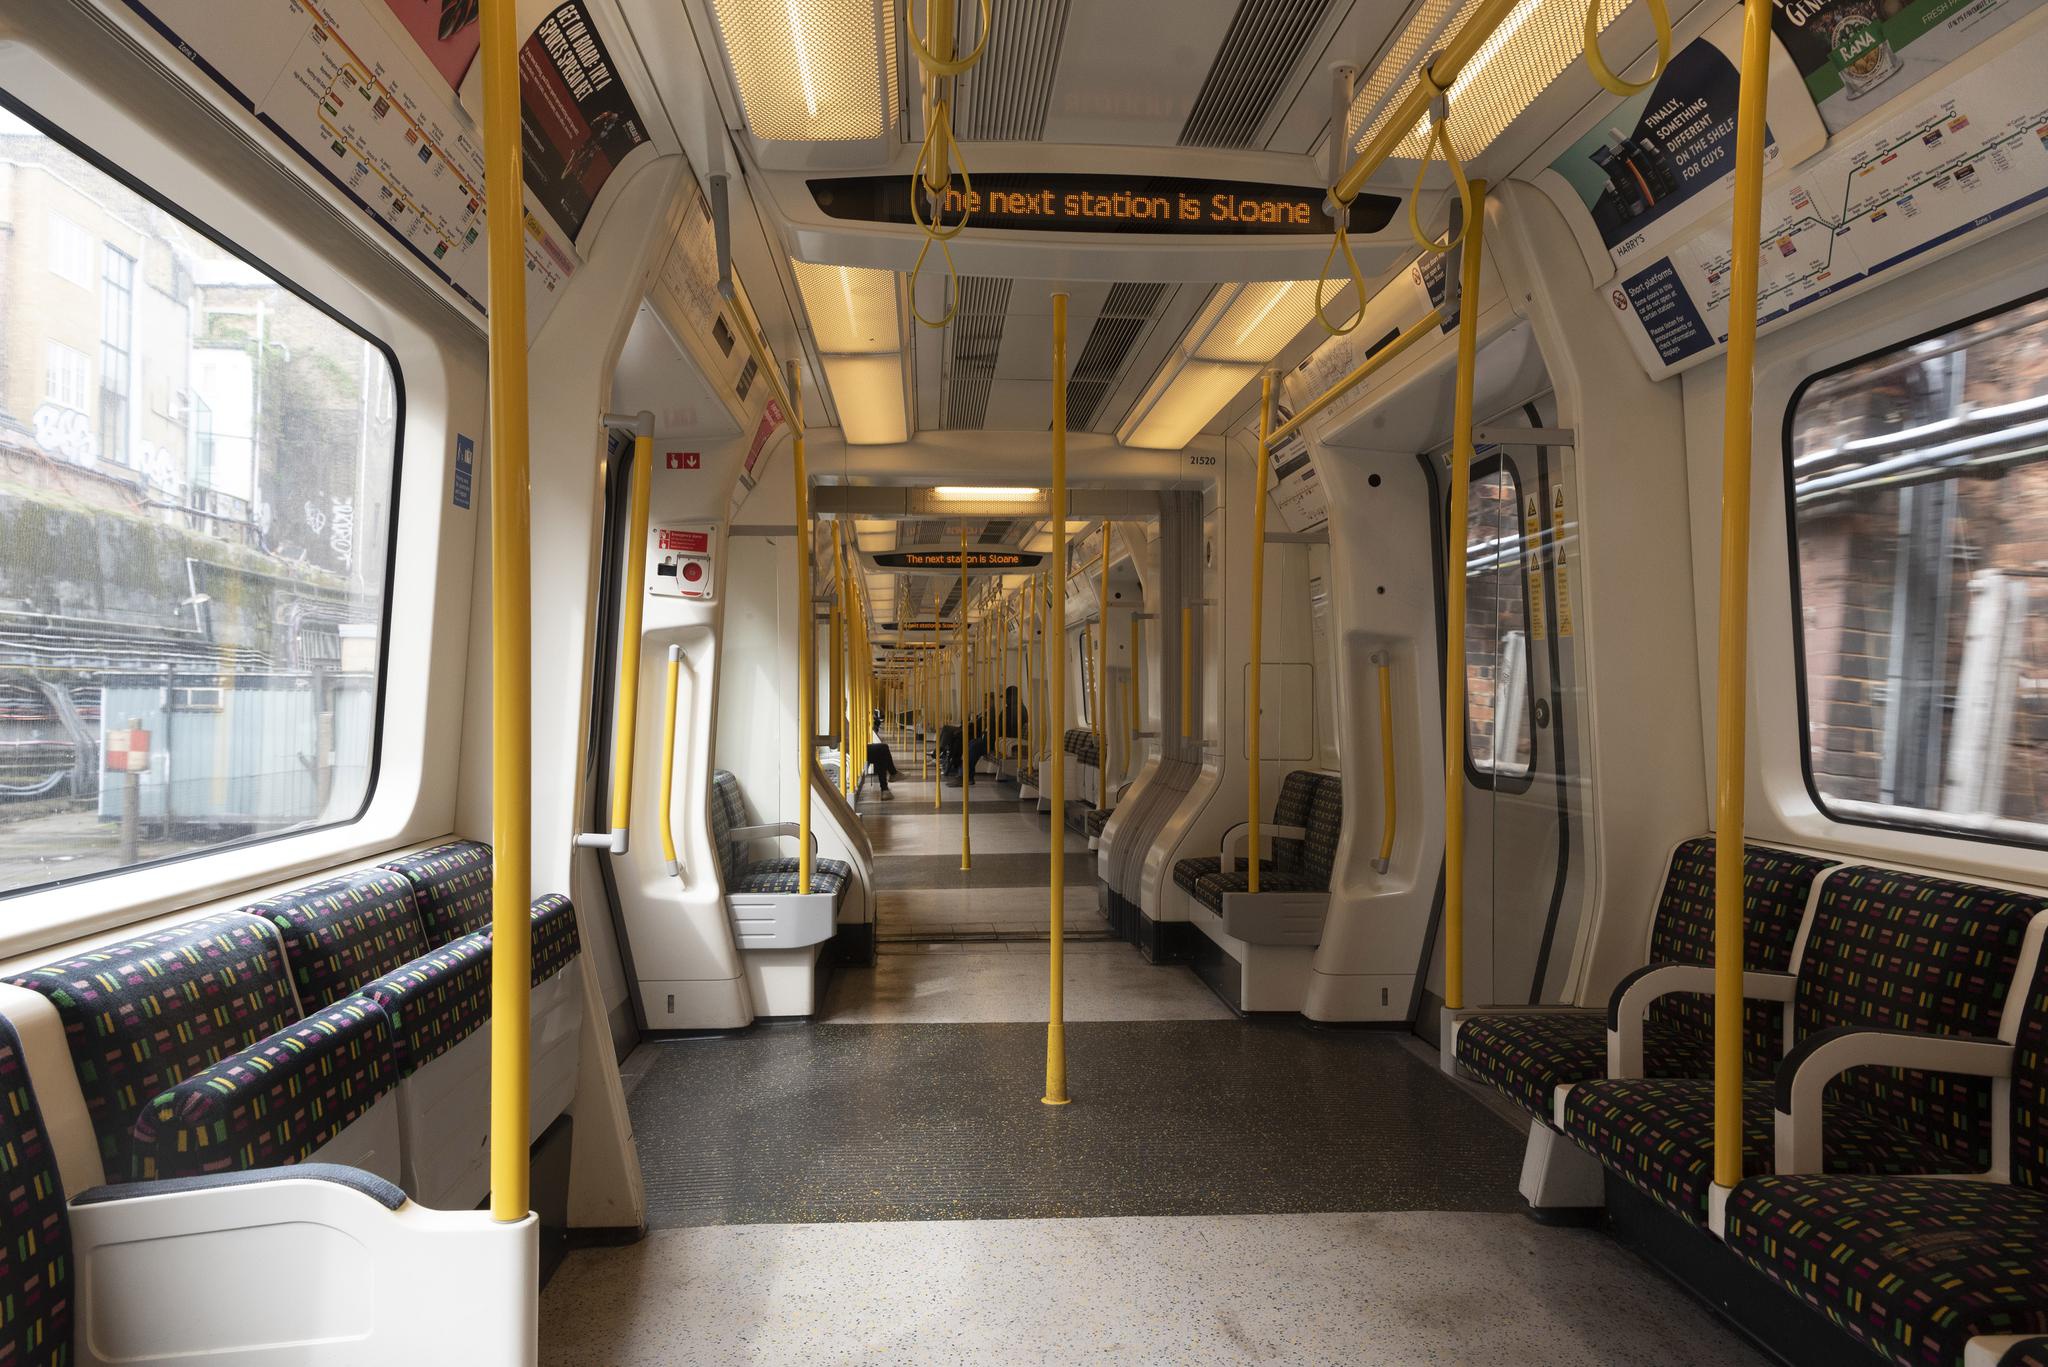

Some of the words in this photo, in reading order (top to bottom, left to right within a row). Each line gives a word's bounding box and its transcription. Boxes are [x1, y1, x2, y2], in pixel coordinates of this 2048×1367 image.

[557, 4, 581, 27] GET
[1922, 3, 1949, 24] FRESH
[566, 21, 587, 41] ON
[1840, 31, 1876, 61] RANA
[539, 18, 569, 60] SPORTS
[557, 50, 585, 89] SPREAD
[574, 79, 594, 102] BET
[572, 34, 600, 68] BOARD:
[588, 62, 610, 84] TRY
[596, 78, 612, 92] A
[1644, 97, 1685, 129] FINALLY,
[1656, 98, 1708, 140] SOMETHING
[1666, 113, 1713, 153] DIFFERENT
[1675, 152, 1690, 167] ON
[1689, 138, 1708, 159] THE
[1707, 117, 1735, 144] SHELF
[1682, 165, 1701, 181] FOR
[1700, 146, 1725, 168] GUYS
[944, 185, 981, 212] he
[990, 190, 1056, 215] next
[1064, 190, 1171, 218] station
[1179, 193, 1200, 220] is
[1210, 194, 1310, 224] Sloane
[1617, 234, 1646, 257] HARRY'S
[1628, 282, 1646, 297] Short
[1645, 267, 1673, 290] platforms
[1190, 456, 1216, 465] 21520
[906, 555, 923, 563] The
[925, 554, 944, 563] next
[946, 554, 977, 563] staon
[979, 555, 986, 563] is
[988, 554, 1019, 563] Sloane
